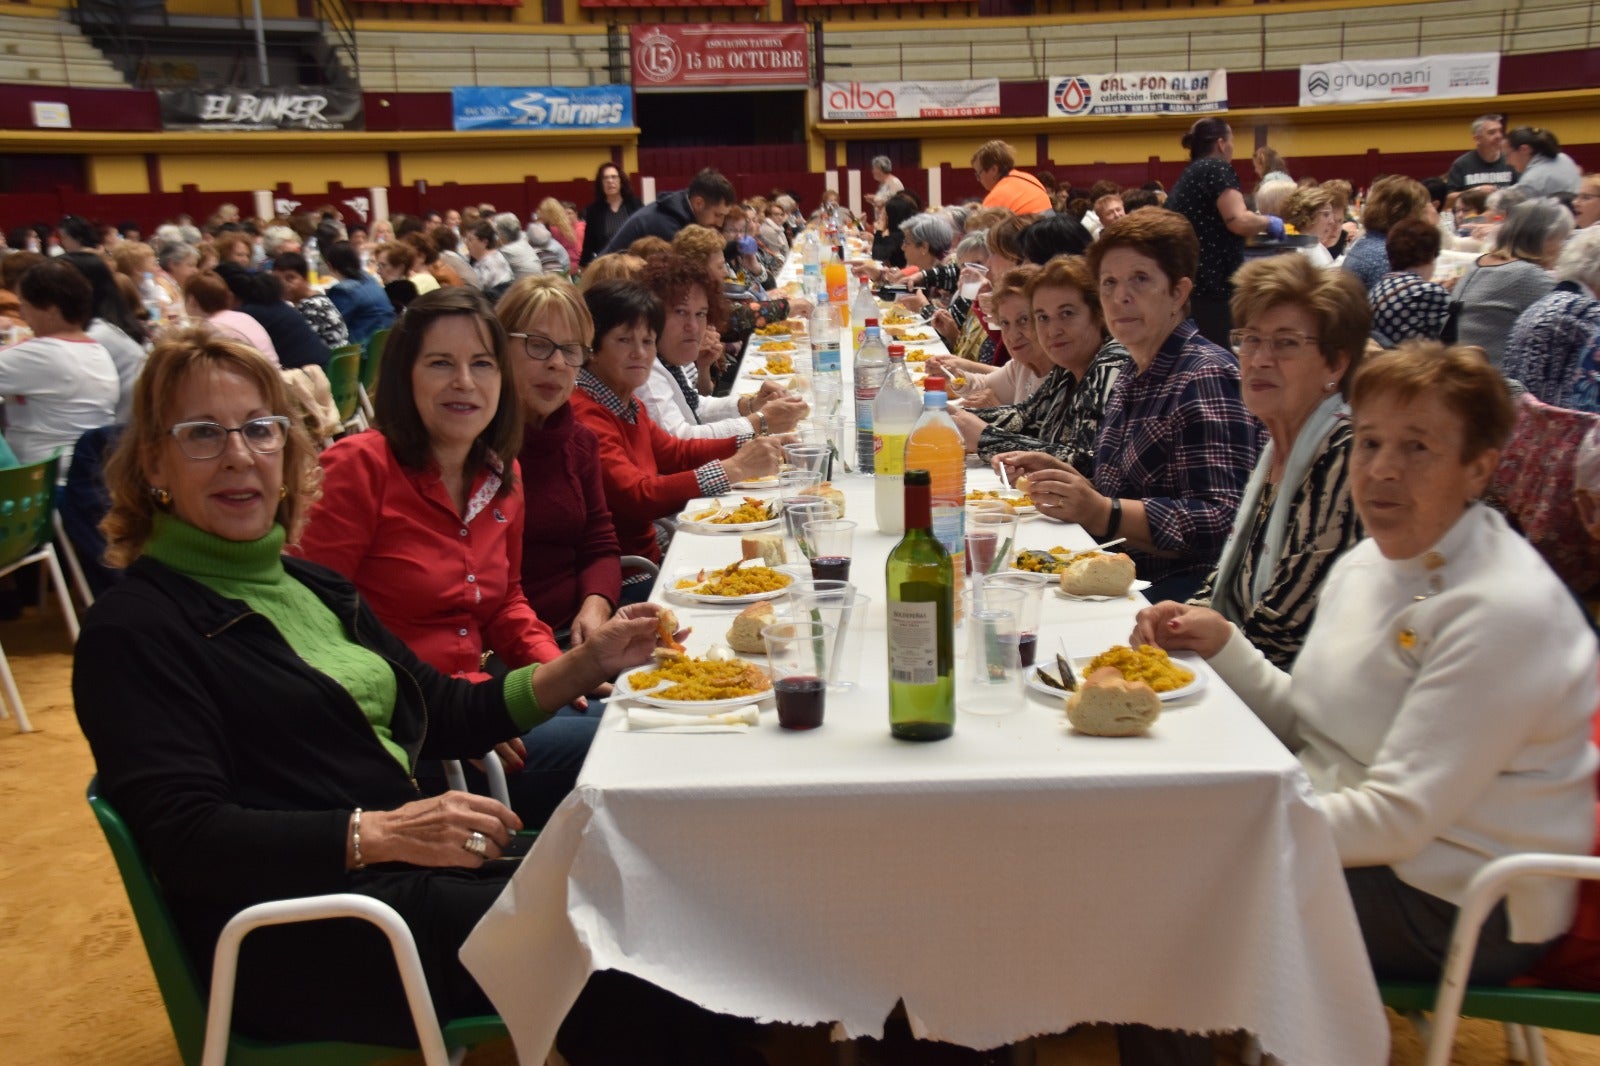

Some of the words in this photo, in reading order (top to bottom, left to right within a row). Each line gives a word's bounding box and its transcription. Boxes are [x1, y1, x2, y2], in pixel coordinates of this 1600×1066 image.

[649, 46, 673, 74] 15
[686, 52, 702, 69] 15
[707, 55, 724, 68] DE
[728, 51, 804, 68] OCTUBRE
[1171, 76, 1209, 91] ALBA
[1333, 66, 1432, 91] gruponani
[201, 94, 236, 120] EL
[232, 93, 329, 122] BUNKER
[829, 80, 895, 110] alba
[545, 97, 624, 124] Tormes
